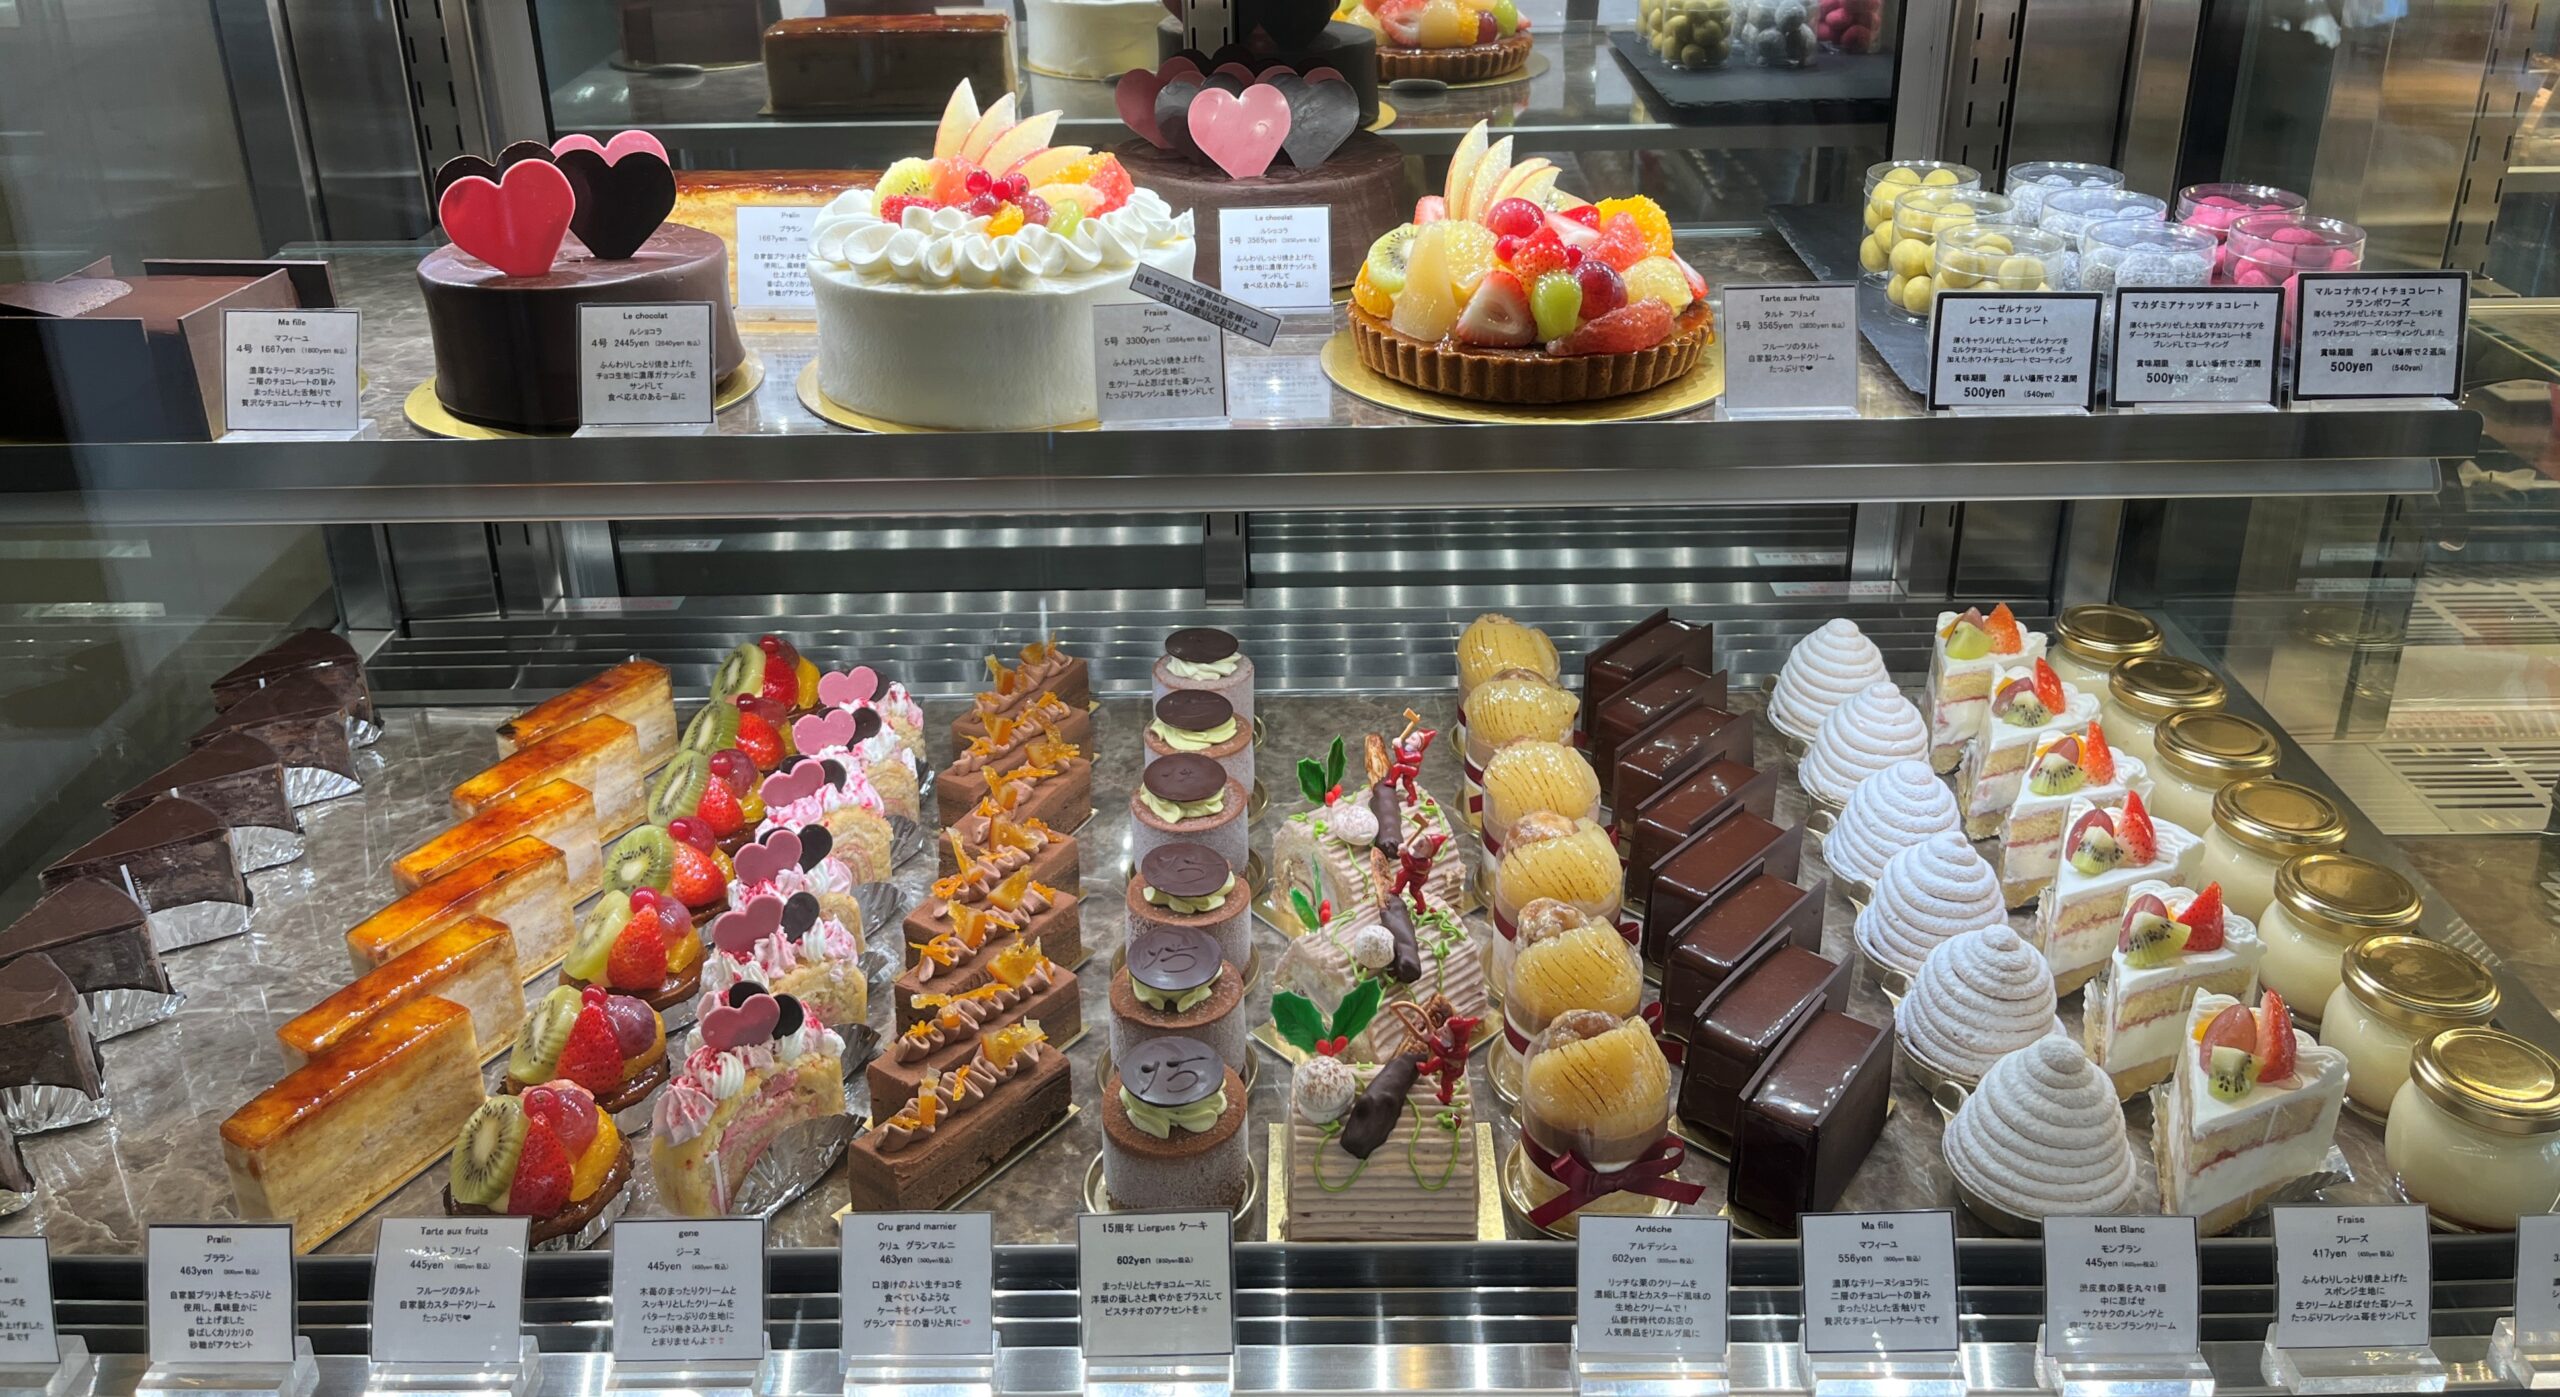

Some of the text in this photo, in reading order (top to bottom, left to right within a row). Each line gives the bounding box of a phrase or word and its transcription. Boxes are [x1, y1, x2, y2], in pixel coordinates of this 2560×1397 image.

[2315, 287, 2443, 295] マルコナホワイトチョコレート
[1979, 305, 2042, 313] ヘーゼルナッツ
[2132, 301, 2259, 309] マカダミアナッツチョコレート
[1764, 310, 1815, 319] タルト フリュイ
[1142, 324, 1171, 333] フレーズ
[1758, 321, 1793, 330] 3565yen
[615, 339, 649, 348] 2445yen
[1126, 336, 1160, 345] 3300yen
[236, 344, 253, 353] 4号
[261, 345, 295, 354] 1667yen
[2321, 348, 2353, 356] 賞味期限
[1749, 354, 1834, 362] 自家製カスタードクリーム
[2331, 362, 2423, 373] 500yen (540yen)
[1955, 374, 1986, 382] 賞味期限
[2146, 373, 2188, 384] 500yen
[630, 382, 663, 390] サンドして
[1964, 387, 2005, 398] 500yen
[2337, 1216, 2365, 1224] Fraise
[877, 1223, 893, 1231] Cru
[896, 1222, 920, 1232] grand
[1103, 1221, 1208, 1233] 15周年 Liergues ケーキ
[1862, 1221, 1894, 1230] Ma fille
[2095, 1225, 2145, 1233] Mont Blanc
[421, 1227, 443, 1235] Tarte
[465, 1227, 488, 1235] fruits
[679, 1231, 699, 1239] gene
[207, 1235, 231, 1244] Pralin
[2336, 1234, 2368, 1244] フレーズ
[878, 1242, 900, 1251] クリュ
[1629, 1242, 1677, 1250] アルデッシュ
[1859, 1241, 1898, 1249] マフィーユ
[2101, 1244, 2141, 1254] モンブラン
[451, 1246, 480, 1256] フリュイ
[676, 1248, 700, 1256] ジーヌ
[2313, 1249, 2347, 1259] 417yen
[880, 1254, 912, 1265] 463yen
[1117, 1256, 1151, 1266] 602yen
[1612, 1254, 1646, 1264] 602yen
[1838, 1254, 1872, 1264] 556yen
[2085, 1258, 2118, 1268] 445yen
[410, 1260, 443, 1270] 445yen
[648, 1261, 681, 1272] 445yen
[180, 1266, 213, 1276] 463yen
[872, 1280, 962, 1289] 口溶けのよい生チョコを
[1102, 1280, 1211, 1290] まったりとしたチョコムースに
[417, 1287, 480, 1295] フルーツのタルト
[884, 1293, 950, 1302] 食べているような
[400, 1300, 495, 1309] 自家製カスタードクリーム
[642, 1299, 734, 1308] スッキリとしたクリームを
[1838, 1303, 1925, 1313] まったりとした舌触りで
[877, 1305, 957, 1315] ケーキをイメージして
[2083, 1309, 2164, 1318] サクサクのメレンゲと
[196, 1315, 244, 1325] 仕上げました
[190, 1341, 252, 1349] 砂糖がアクセント
